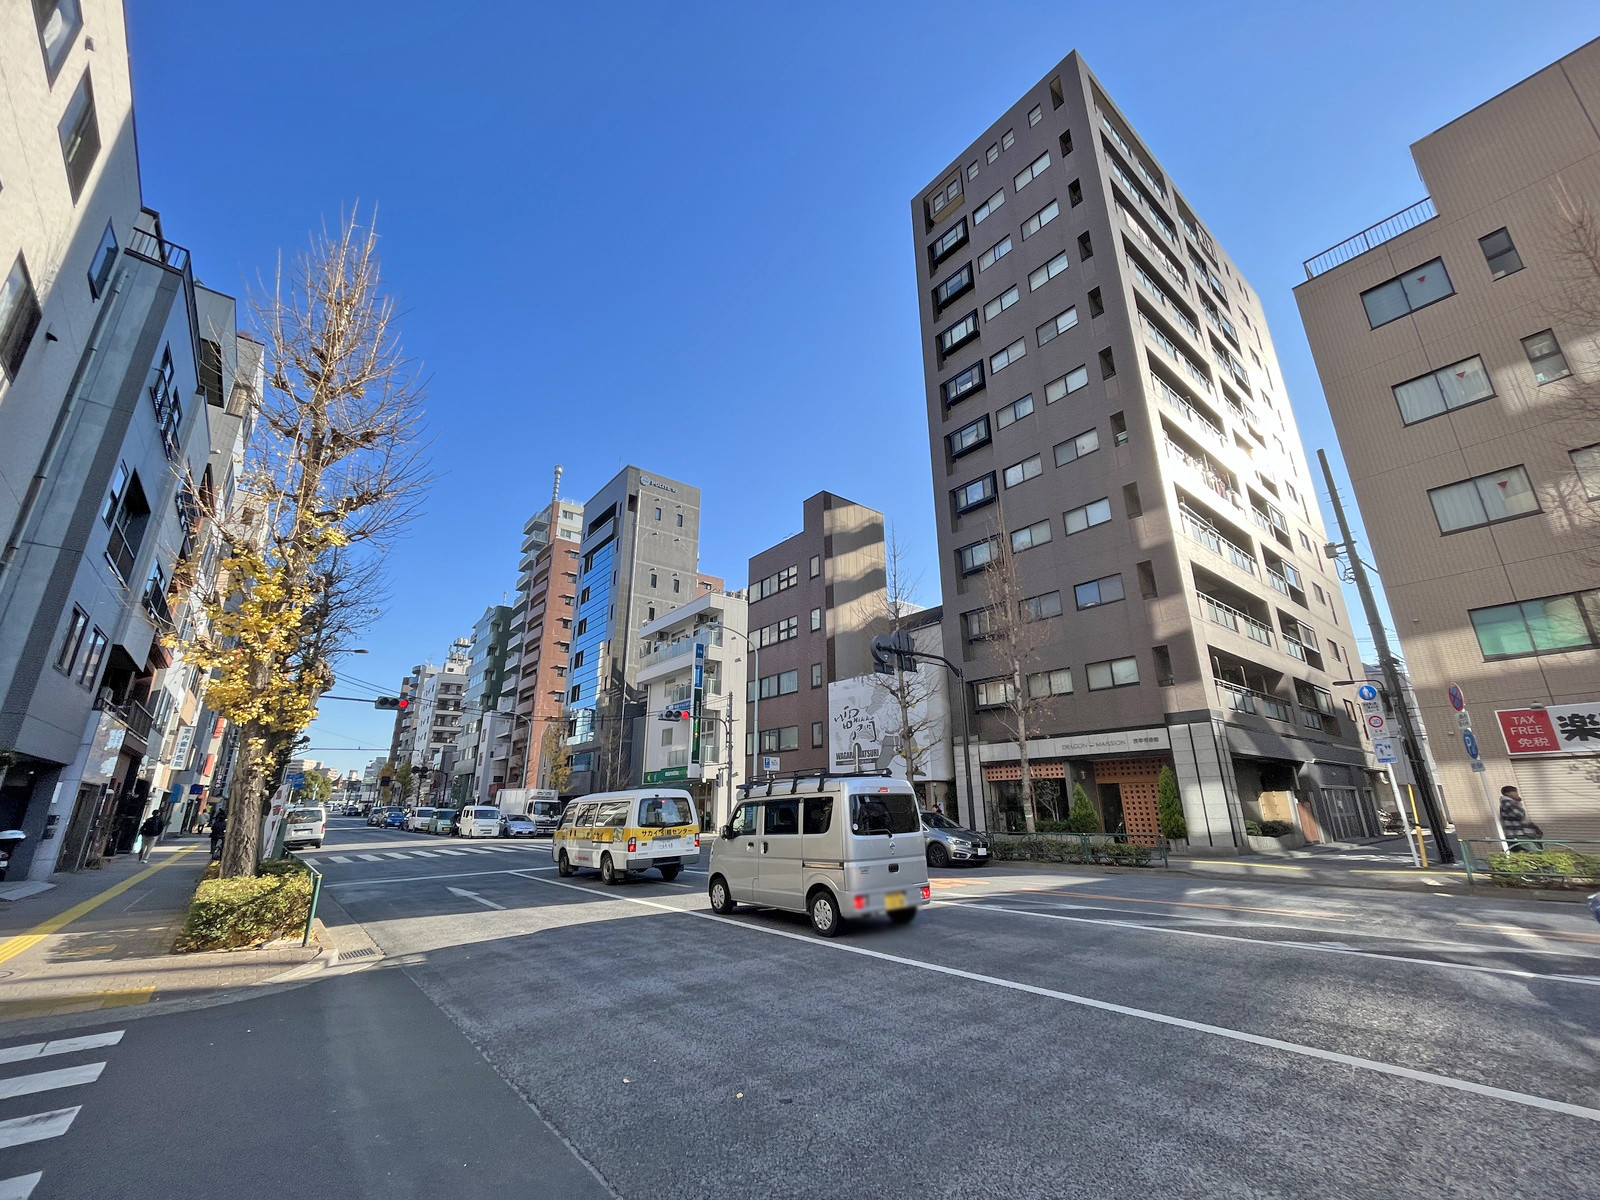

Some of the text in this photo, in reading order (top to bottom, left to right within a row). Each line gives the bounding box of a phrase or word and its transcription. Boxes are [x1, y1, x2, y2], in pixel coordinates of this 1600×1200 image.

[1511, 715, 1537, 725] TAX
[1510, 725, 1545, 736] FREE
[1062, 742, 1088, 750] DRAGON
[1096, 739, 1127, 748] MANSION
[1518, 736, 1551, 748] 免税
